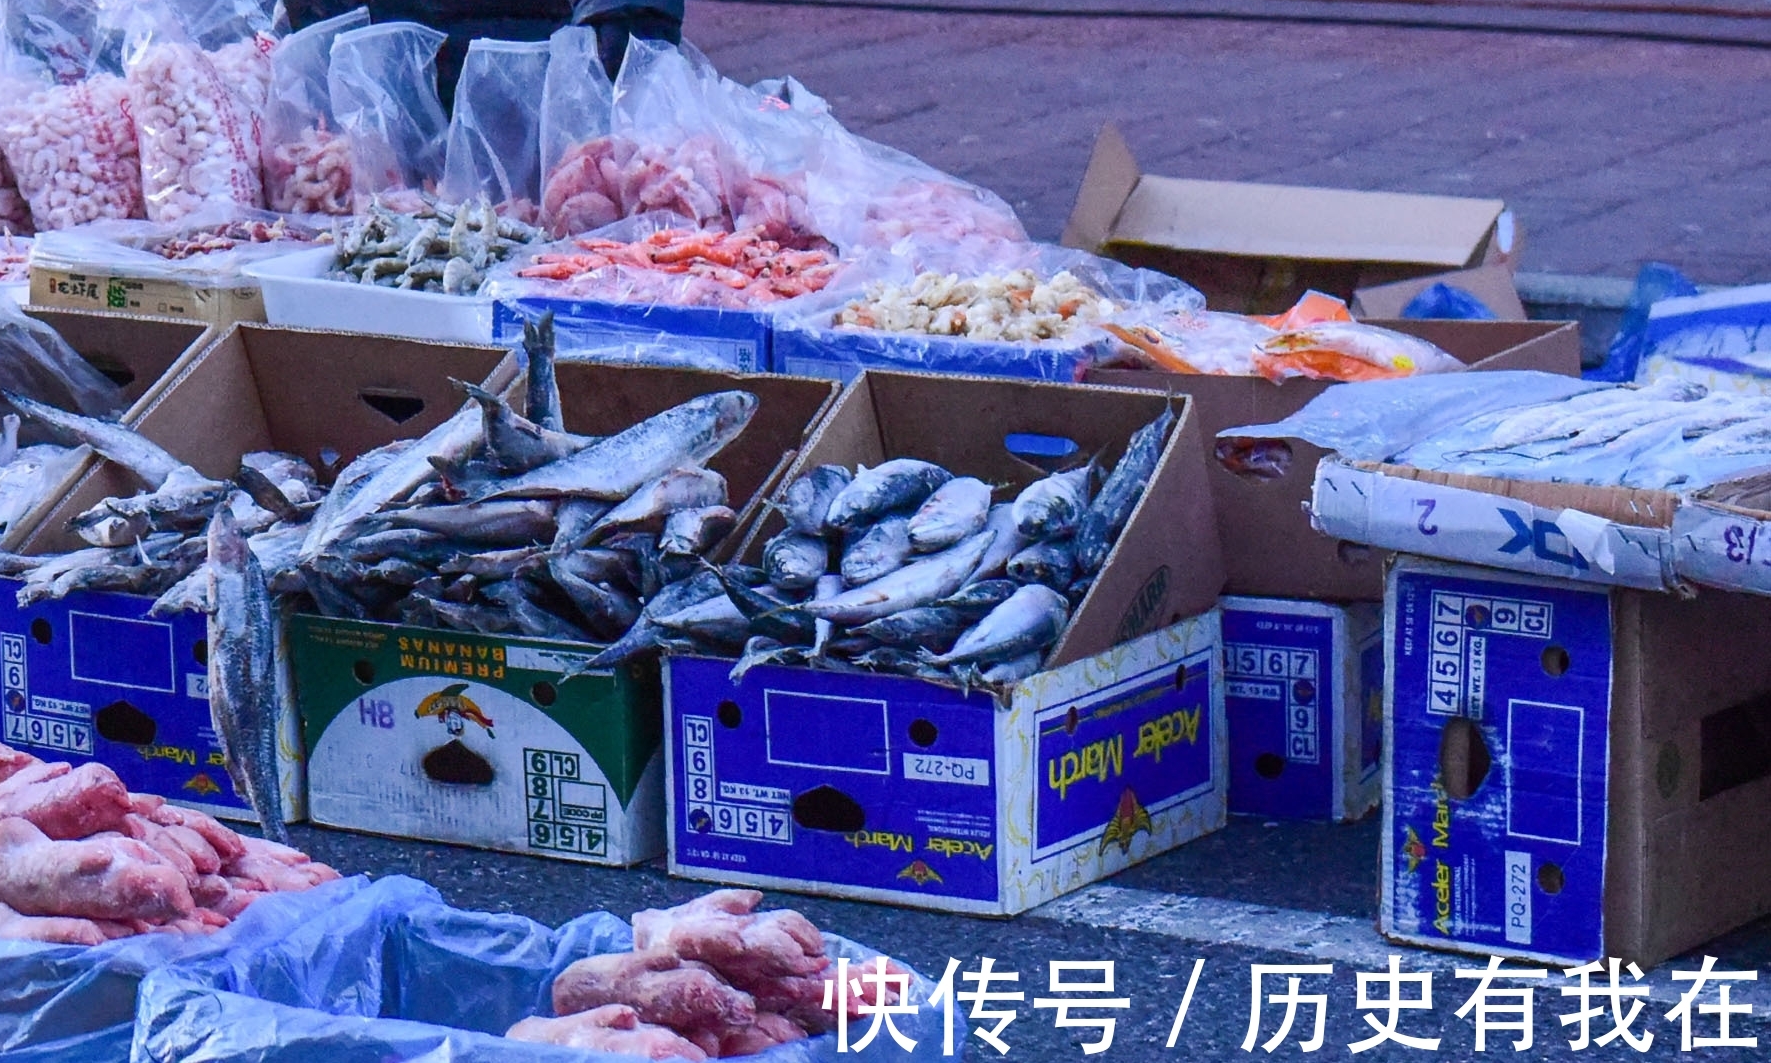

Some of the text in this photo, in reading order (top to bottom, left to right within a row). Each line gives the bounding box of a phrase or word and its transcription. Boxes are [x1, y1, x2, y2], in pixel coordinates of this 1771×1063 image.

[1494, 609, 1516, 625] 9
[1524, 606, 1546, 631] CL
[4, 640, 22, 659] CL
[397, 636, 505, 660] BANANAS
[1432, 600, 1460, 707] 4 5 6 7
[399, 655, 505, 679] PREMIUM
[1242, 651, 1309, 675] 5 6 7
[9, 666, 20, 687] 9
[358, 697, 395, 729] 8H
[1294, 709, 1309, 730] 9
[10, 718, 86, 748] 7 6 5 4
[687, 721, 708, 744] CL
[1047, 732, 1123, 802] March
[1132, 701, 1202, 763] Aceler
[1292, 736, 1314, 756] CL
[531, 753, 576, 776] 9 CL
[692, 751, 706, 773] 9
[914, 758, 976, 781] PQ-272
[532, 776, 548, 797] 8
[693, 777, 706, 801] 8
[533, 800, 549, 820] 7
[718, 808, 784, 836] 6 5 4
[534, 825, 602, 851] 6 5 4
[924, 838, 993, 861] Aceler
[1432, 859, 1450, 935] Aceler
[1511, 863, 1527, 929] PQ-272
